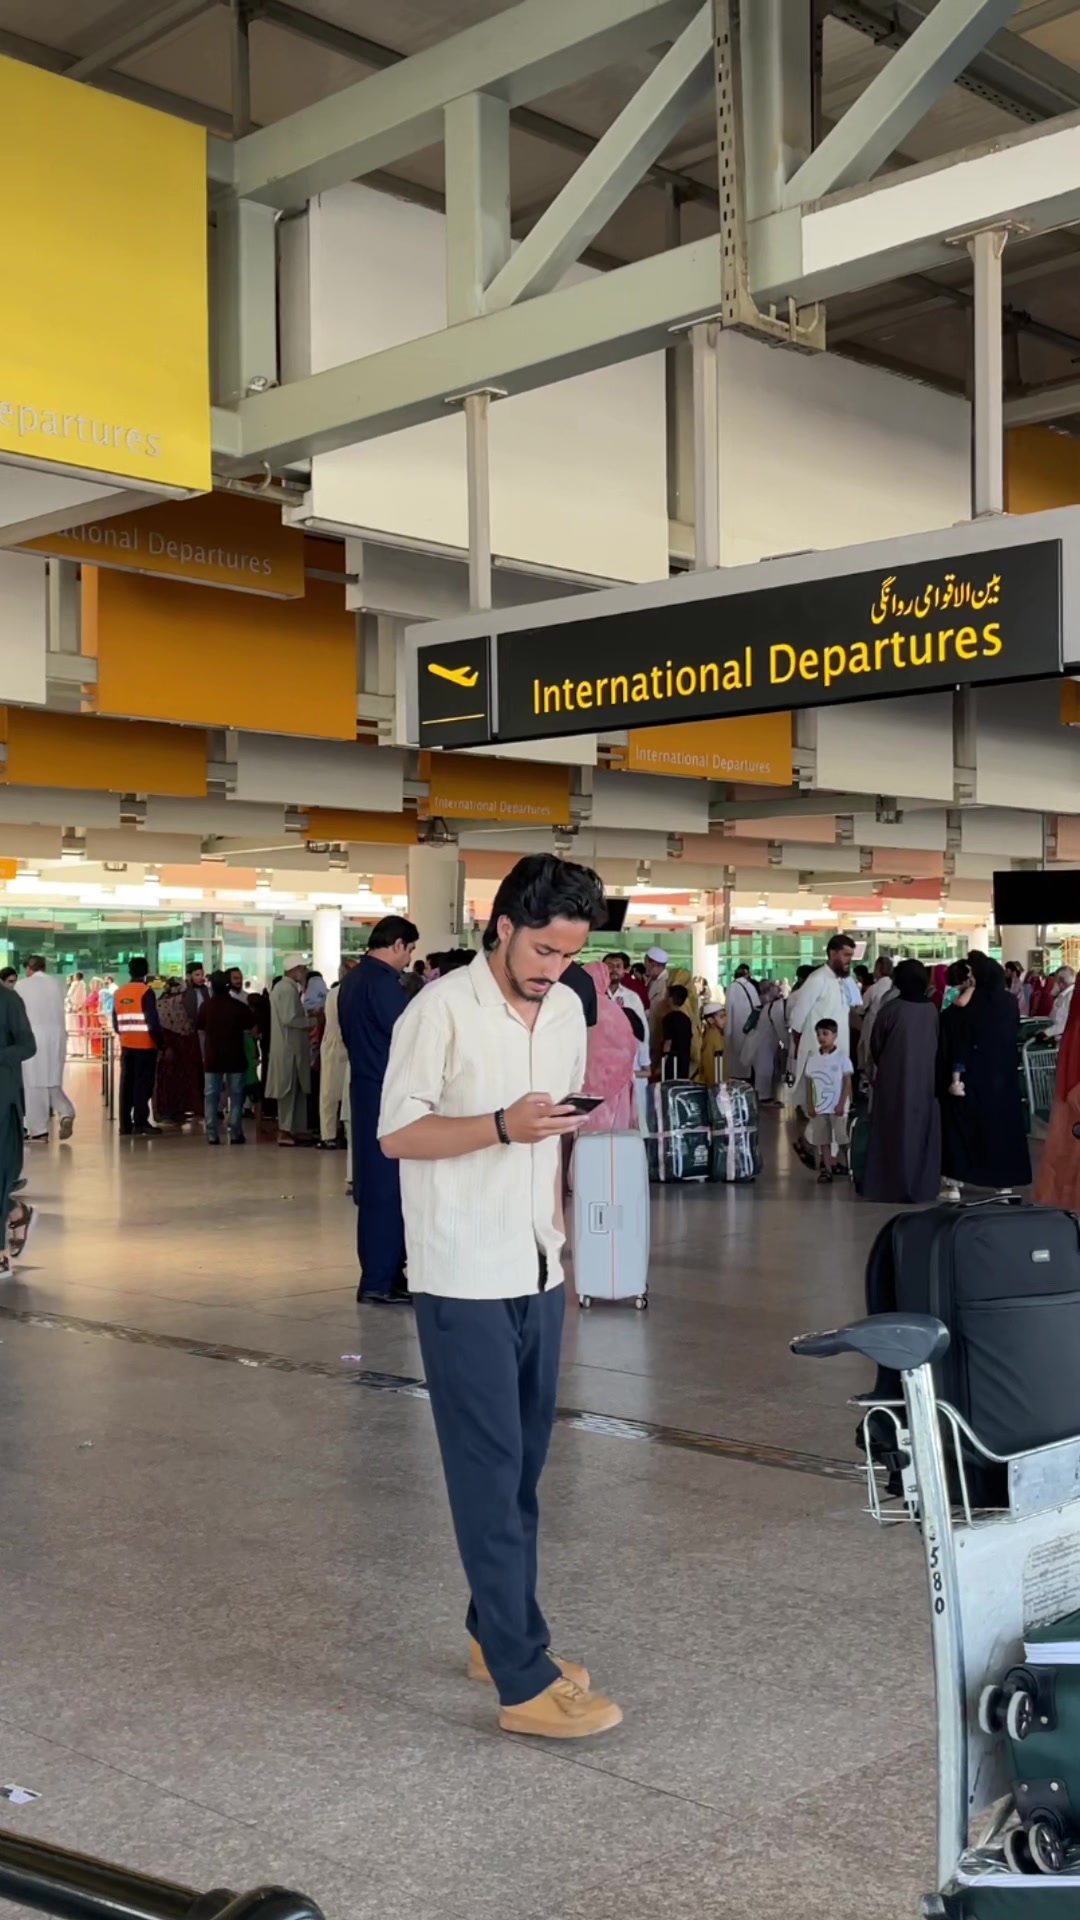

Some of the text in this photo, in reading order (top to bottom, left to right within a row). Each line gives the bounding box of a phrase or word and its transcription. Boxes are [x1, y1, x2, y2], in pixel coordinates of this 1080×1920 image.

[147, 531, 272, 576] Departures
[533, 621, 1003, 714] International Departures
[635, 744, 770, 773] International Departures
[434, 796, 551, 816] International Departures
